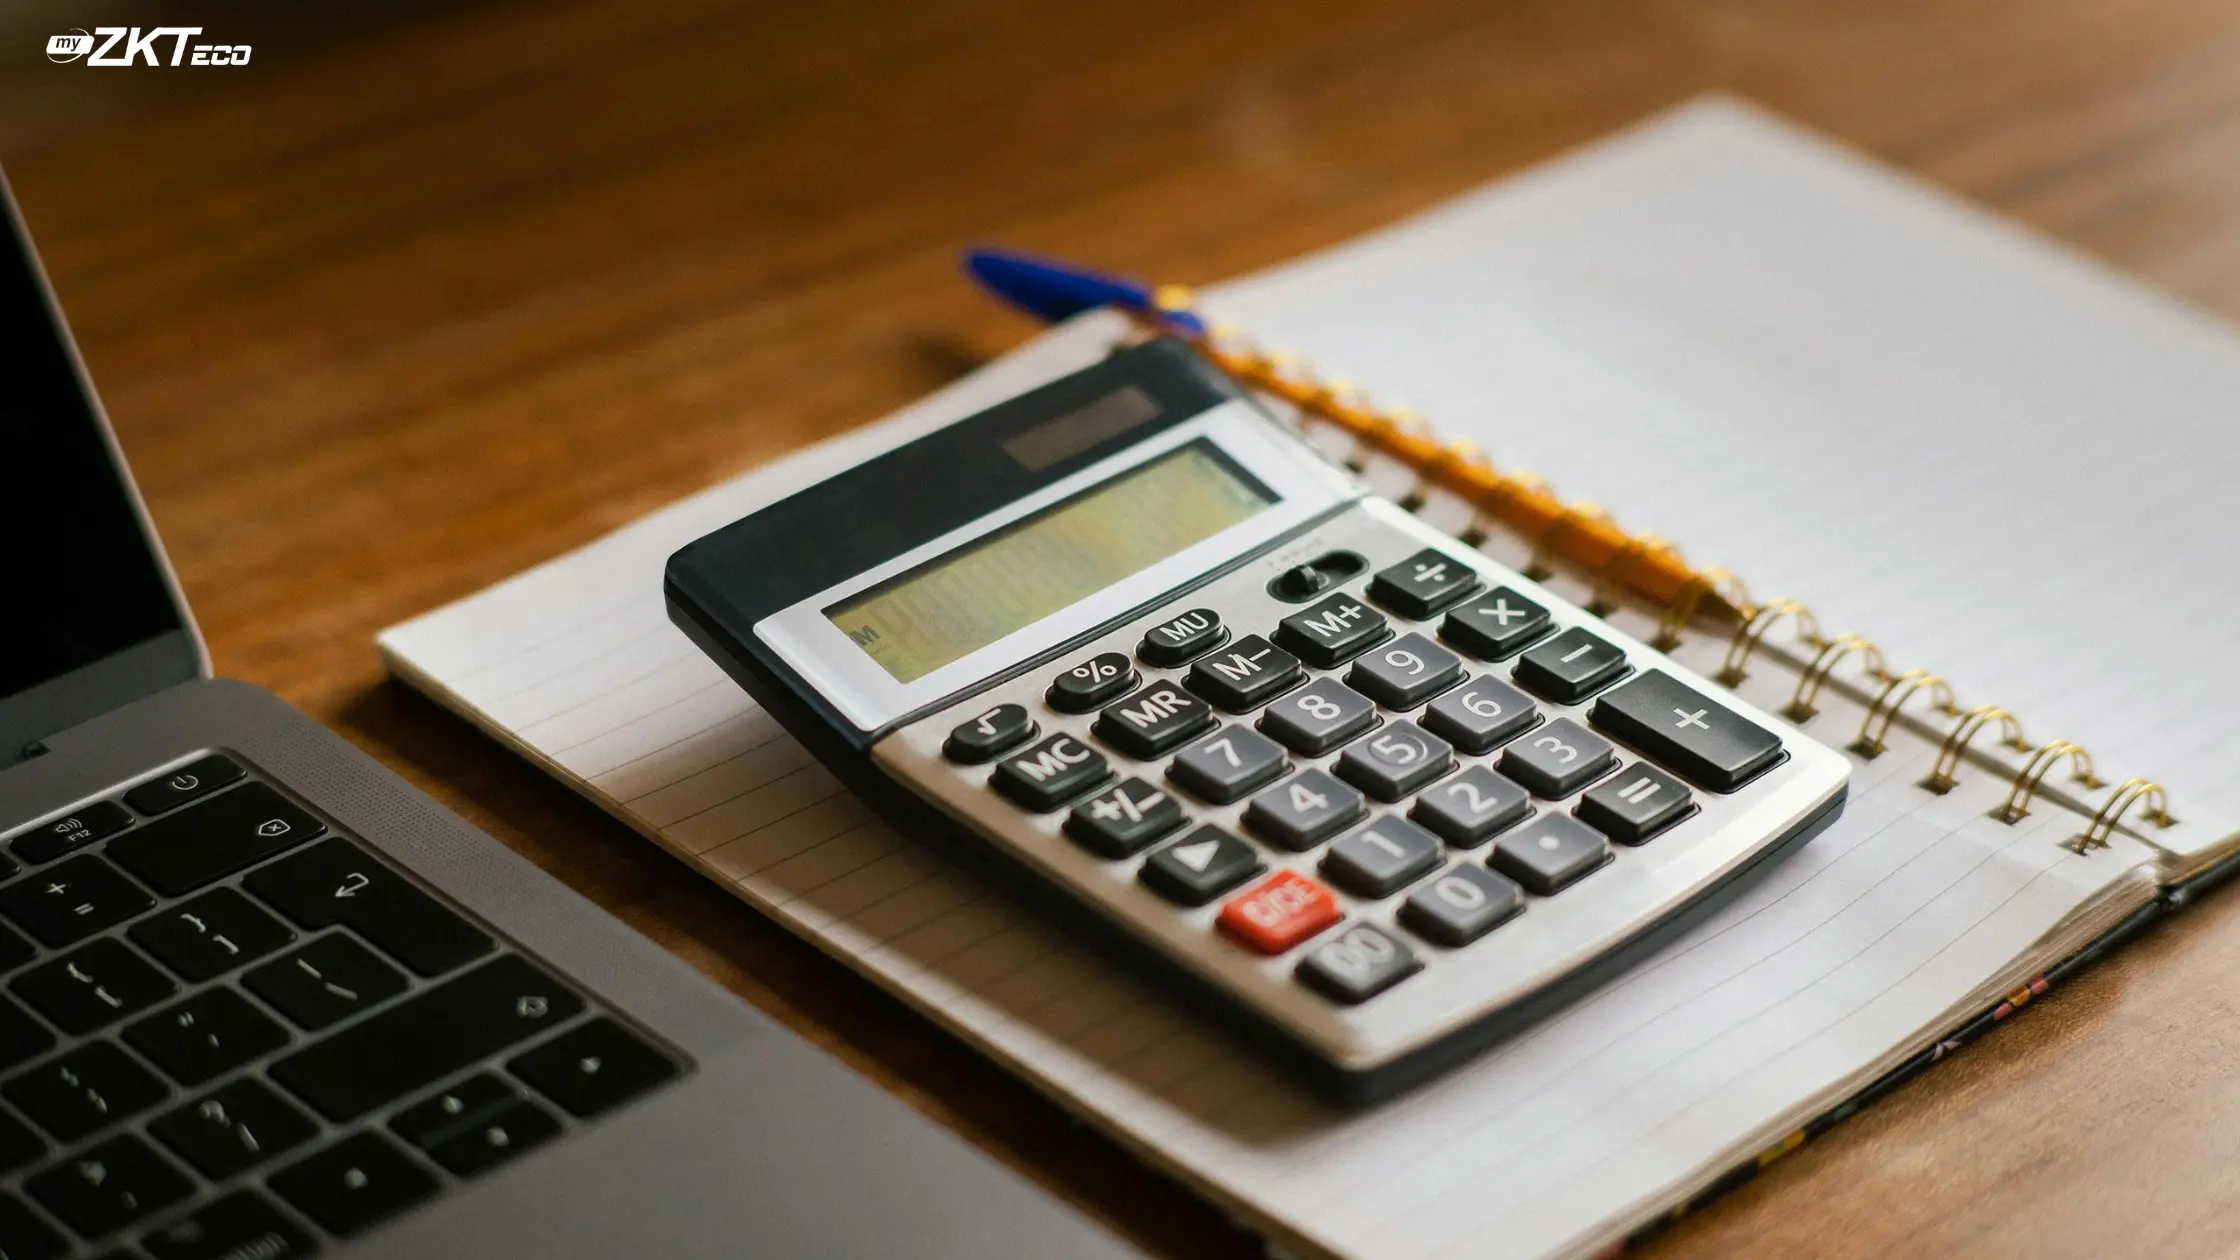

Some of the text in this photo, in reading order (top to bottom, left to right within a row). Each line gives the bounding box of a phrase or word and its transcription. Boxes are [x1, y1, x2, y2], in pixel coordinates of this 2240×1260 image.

[1158, 608, 1210, 644] MU
[1303, 602, 1364, 638] M+
[1384, 649, 1426, 676] 9
[1119, 689, 1193, 731] MR
[1297, 694, 1341, 721] 8
[1461, 690, 1502, 720] 6
[1015, 737, 1091, 783] MC
[1203, 736, 1243, 769] 7
[1367, 732, 1414, 765] 5
[1533, 733, 1578, 764] 3
[1288, 782, 1329, 813] 4
[1447, 782, 1498, 814] 2
[68, 829, 92, 842] F12
[1360, 830, 1405, 858] 1
[1435, 876, 1486, 911] 0
